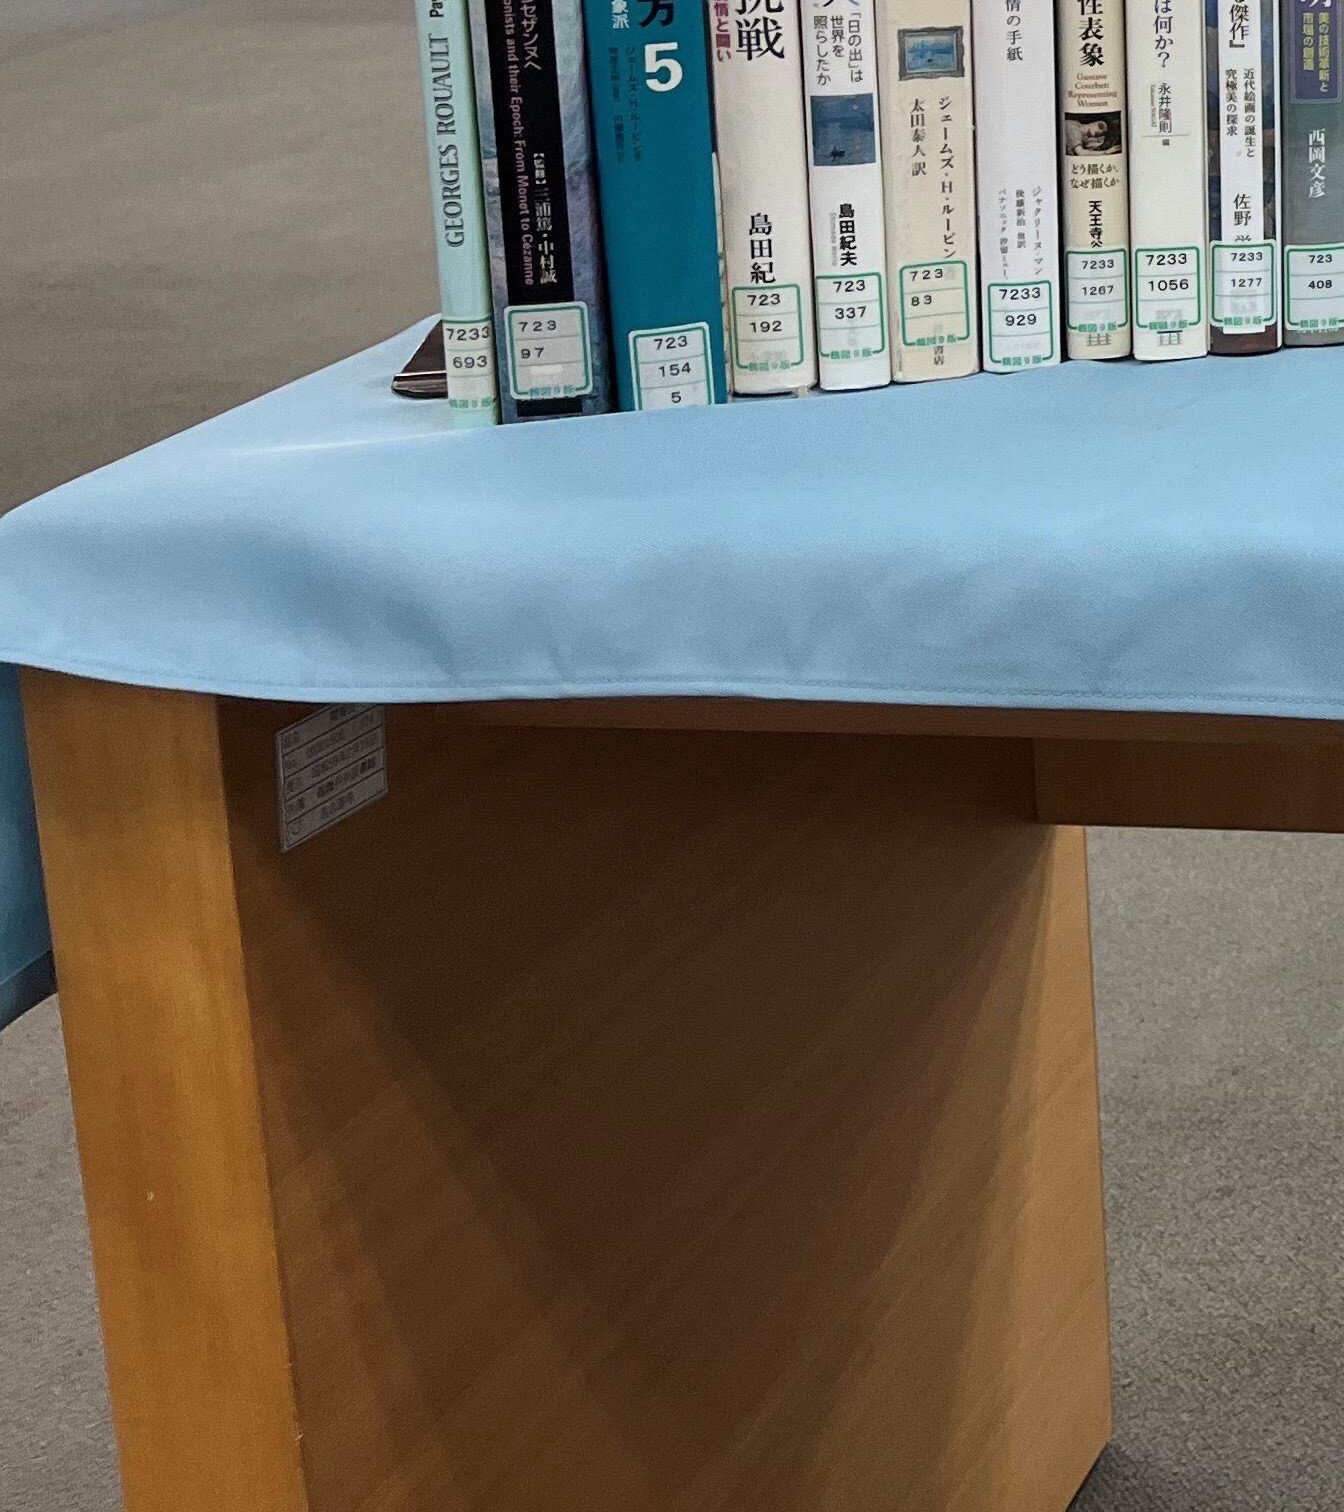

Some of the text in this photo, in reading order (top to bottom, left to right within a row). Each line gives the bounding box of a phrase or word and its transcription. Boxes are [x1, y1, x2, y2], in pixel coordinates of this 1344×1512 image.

[830, 15, 845, 58] 世界を
[506, 38, 520, 63] and
[812, 15, 832, 86] 照らしたか
[643, 41, 684, 92] 5
[508, 65, 522, 93] their
[1077, 99, 1108, 107] Women
[1157, 82, 1173, 135] 永井隆則
[1225, 68, 1238, 136] 究極美の探求
[1243, 67, 1257, 158] 近代絵画の誕生と
[909, 98, 927, 157] 太田泰人
[429, 33, 467, 248] GEORGES ROUAULT
[513, 138, 527, 172] From
[1308, 127, 1327, 199] 西岡文彦
[938, 95, 957, 260] ジェームズ・H・ルービン
[516, 175, 530, 214] Monet
[838, 203, 858, 267] 島田紀夫
[749, 212, 776, 284] 島田紀
[1145, 253, 1188, 266] 7233
[1230, 251, 1263, 262] 7233
[1308, 254, 1333, 264] 723
[1081, 260, 1115, 270] 7233
[909, 268, 944, 282] 723
[1231, 277, 1263, 288] 1277
[833, 279, 867, 292] 723
[1081, 284, 1115, 296] 1267
[1147, 279, 1189, 292] 1056
[1308, 279, 1333, 289] 408
[747, 294, 781, 307] 723
[910, 294, 933, 307] 83
[998, 287, 1042, 301] 7233
[834, 305, 868, 319] 337
[516, 320, 558, 333] 723
[750, 320, 783, 333] 192
[1005, 314, 1037, 327] 929
[445, 325, 490, 342] 7233
[653, 335, 688, 350] 723
[520, 348, 545, 360] 97
[452, 355, 488, 370] 693
[658, 362, 692, 378] 154
